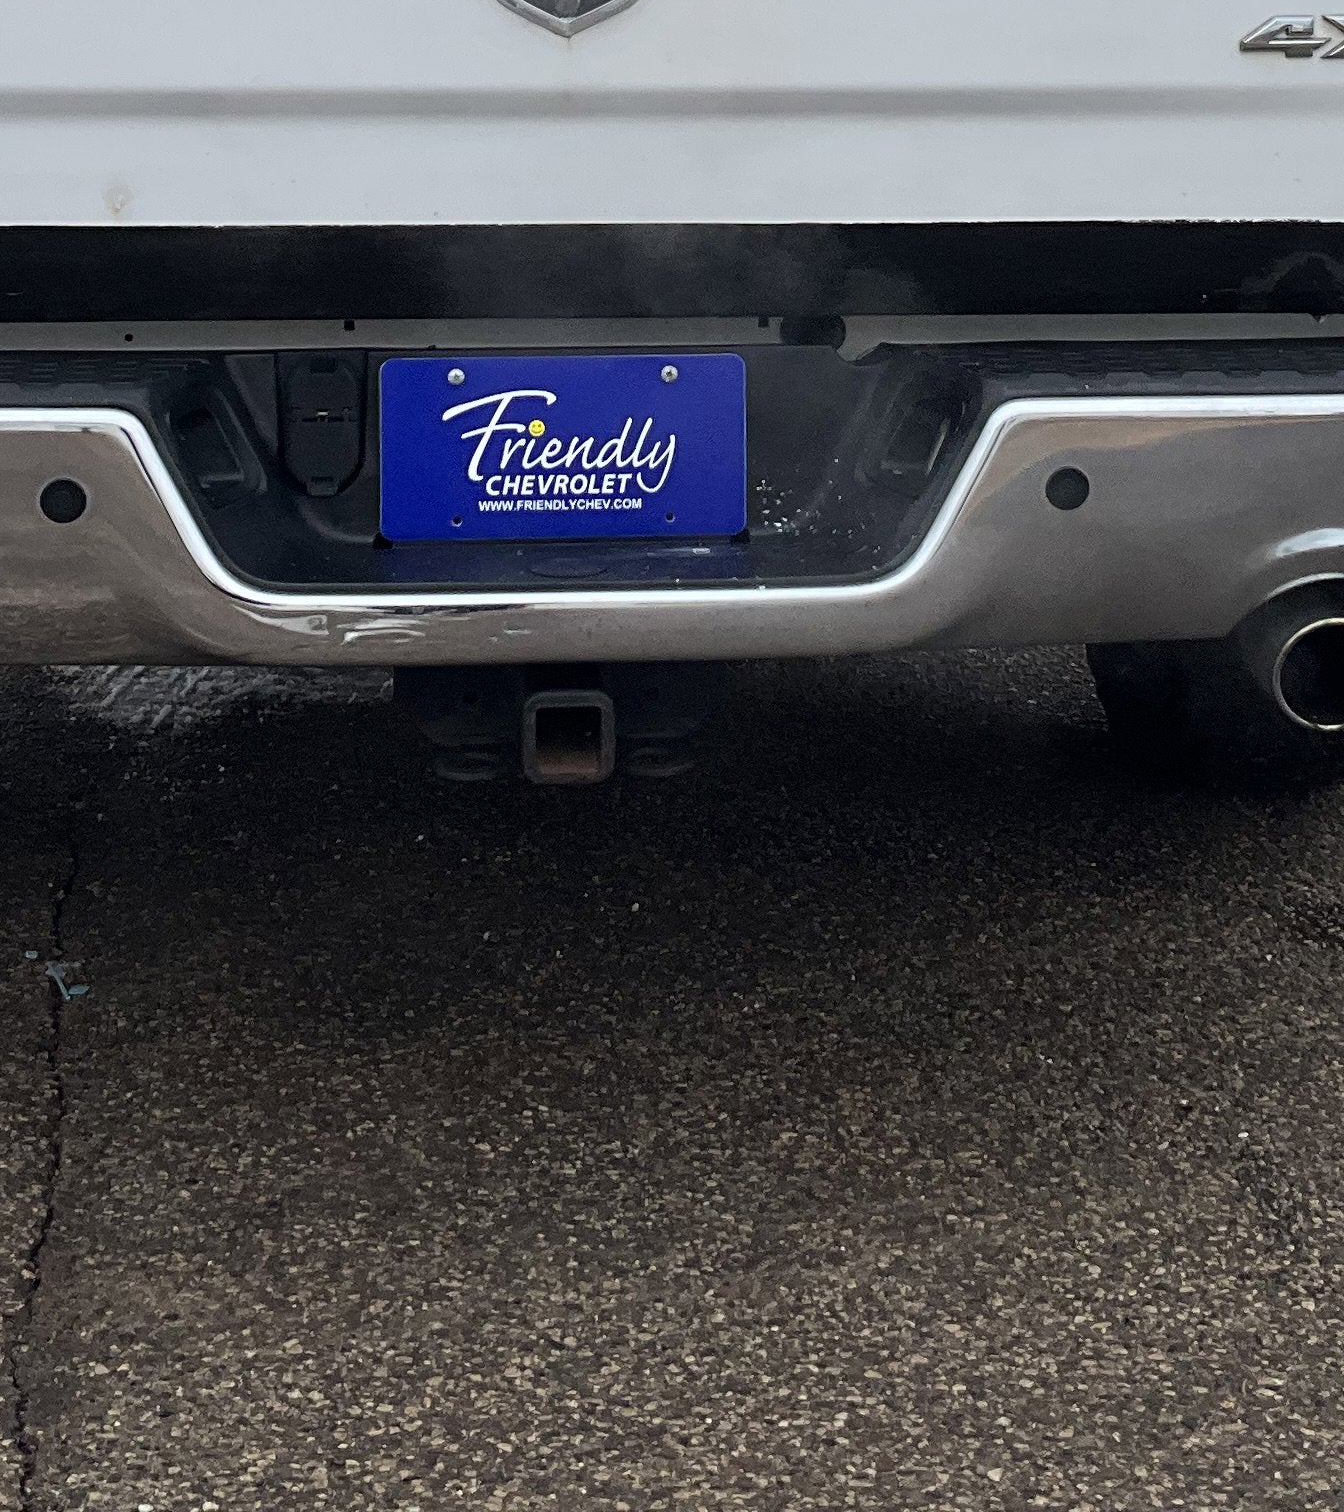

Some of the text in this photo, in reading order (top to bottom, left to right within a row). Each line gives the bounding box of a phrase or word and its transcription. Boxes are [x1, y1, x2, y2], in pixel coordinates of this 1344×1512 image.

[441, 389, 676, 494] Friendly
[485, 471, 633, 497] CHEVROLET
[478, 497, 643, 513] WWW.FRIENDLYCHEV.COM
